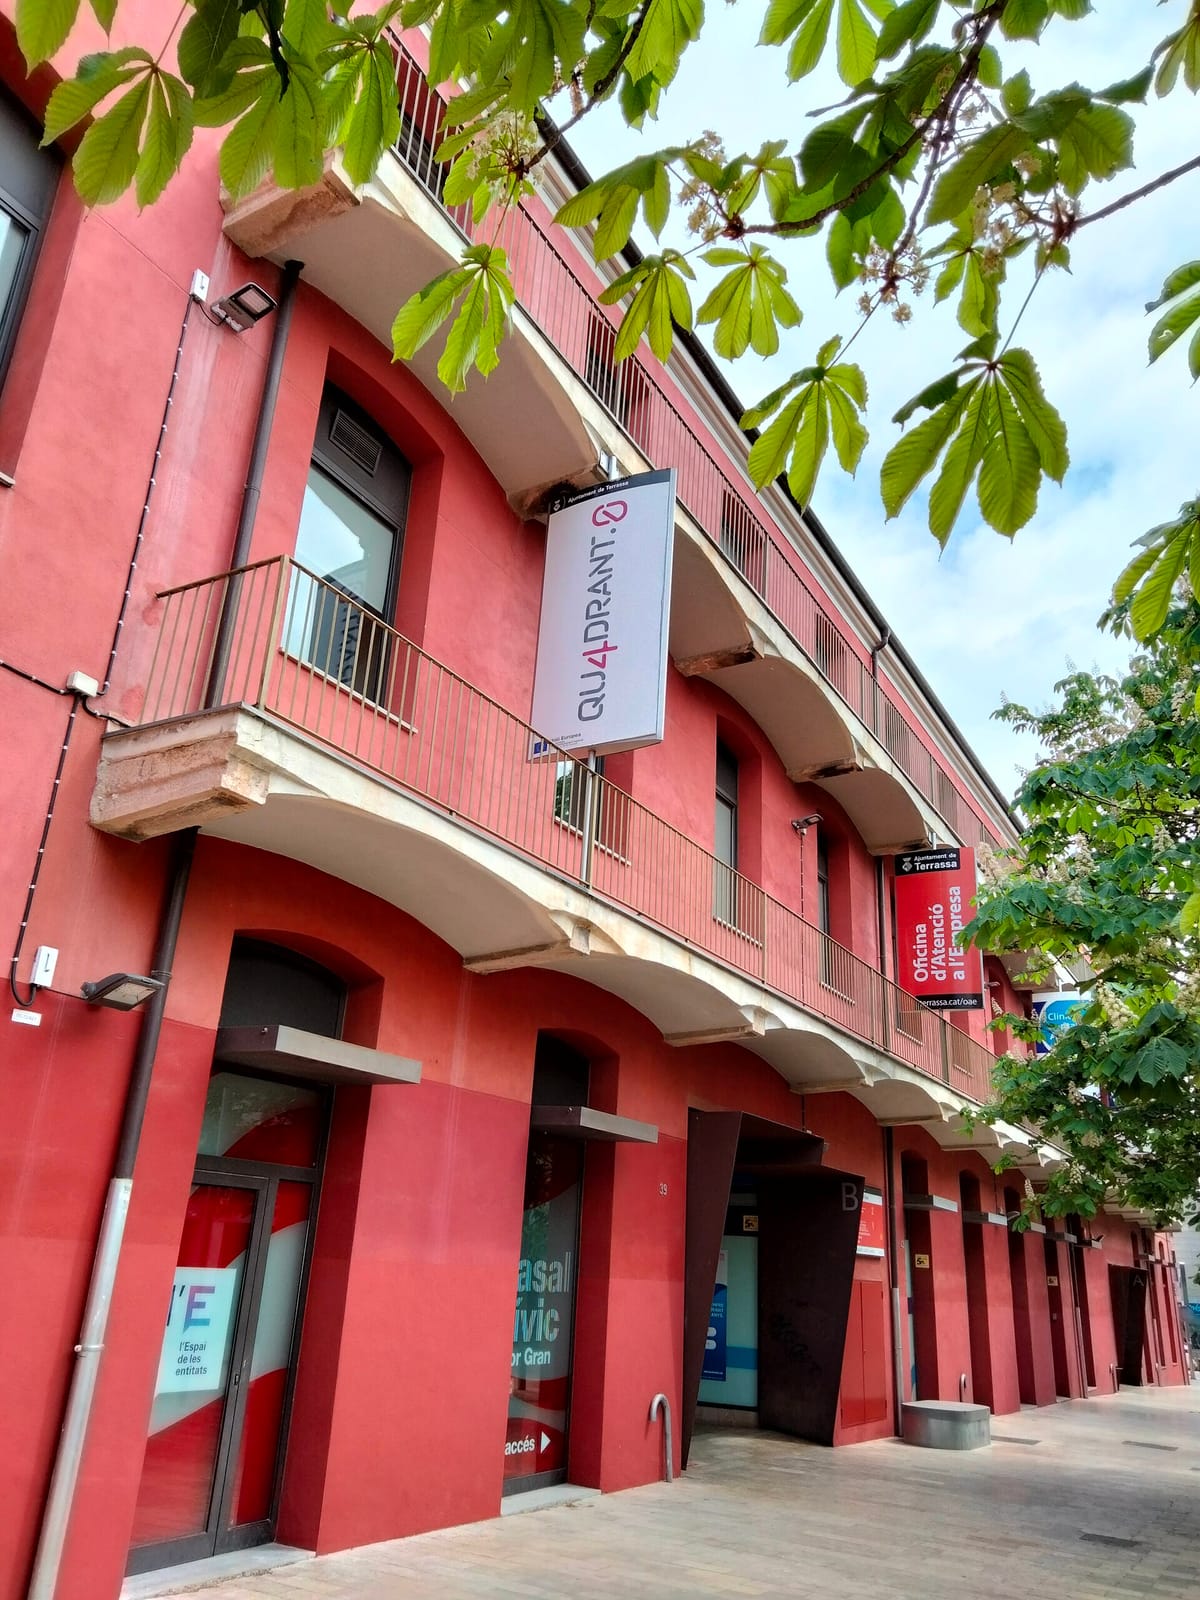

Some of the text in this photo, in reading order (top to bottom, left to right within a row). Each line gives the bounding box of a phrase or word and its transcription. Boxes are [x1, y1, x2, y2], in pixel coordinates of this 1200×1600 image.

[567, 489, 597, 503] Ajuntament
[606, 480, 629, 491] Terrassa
[914, 853, 947, 862] Ajuntament
[914, 861, 957, 871] Terrassa
[928, 903, 947, 981] d'Atenció
[913, 923, 929, 982] Oficina
[953, 969, 965, 981] a
[923, 997, 977, 1007] errassa.cat/oae
[659, 1182, 668, 1196] 39
[841, 1182, 859, 1211] B
[517, 1251, 572, 1293] asal
[1132, 1274, 1145, 1287] A
[513, 1296, 561, 1342] ívic
[179, 1341, 207, 1353] l'Espai
[177, 1353, 201, 1364] de les
[511, 1347, 551, 1366] or Gran
[175, 1366, 208, 1377] entitats
[504, 1434, 536, 1456] accés
